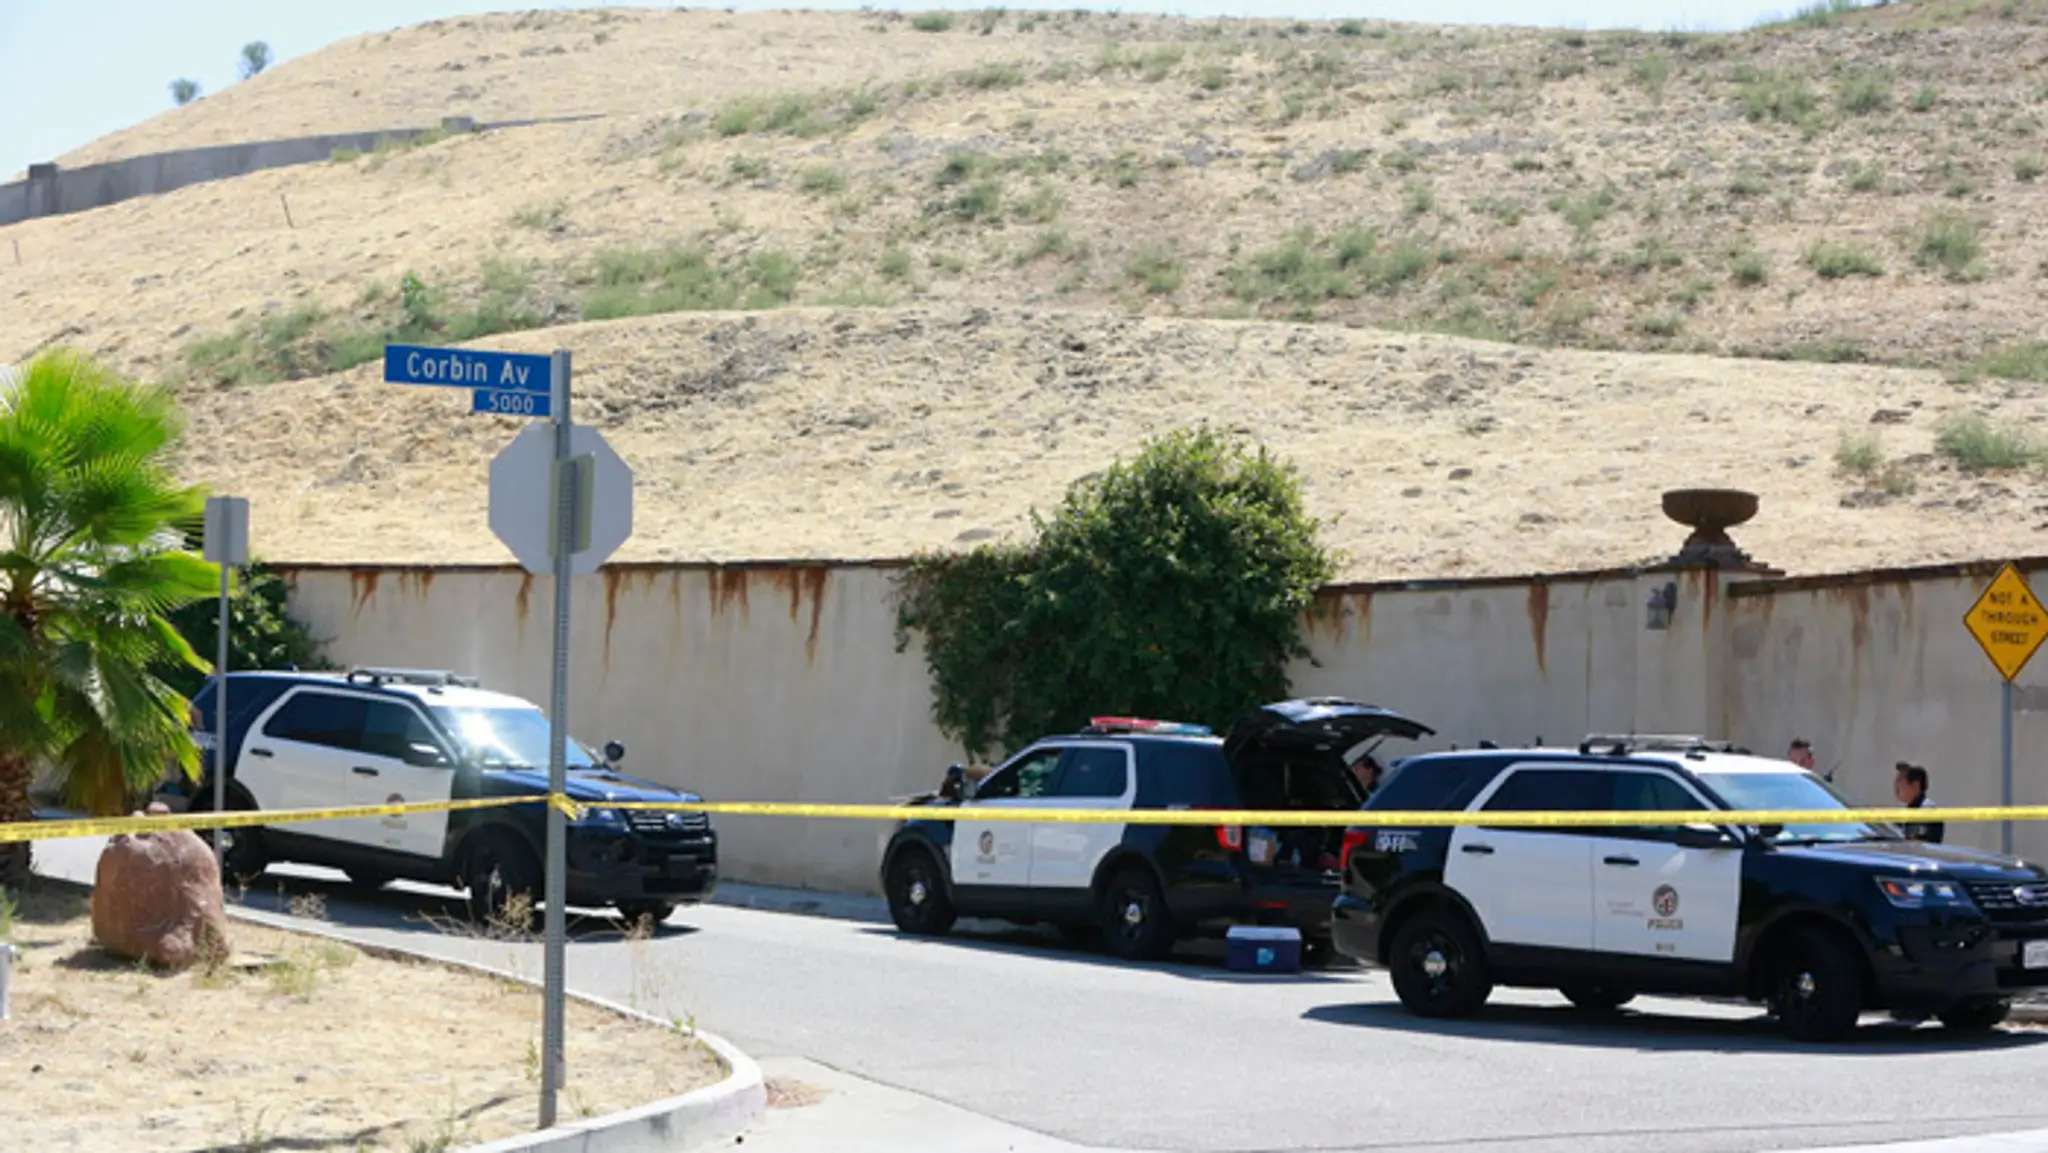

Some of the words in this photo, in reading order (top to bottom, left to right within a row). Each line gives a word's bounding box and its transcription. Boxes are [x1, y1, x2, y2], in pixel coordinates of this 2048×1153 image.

[406, 351, 488, 382] Corbin
[500, 359, 530, 385] Av
[488, 392, 534, 414] 5000
[1989, 591, 2012, 605] NOT
[2020, 594, 2029, 606] A
[1982, 610, 2038, 625] THROUGH
[1990, 630, 2029, 644] STREET
